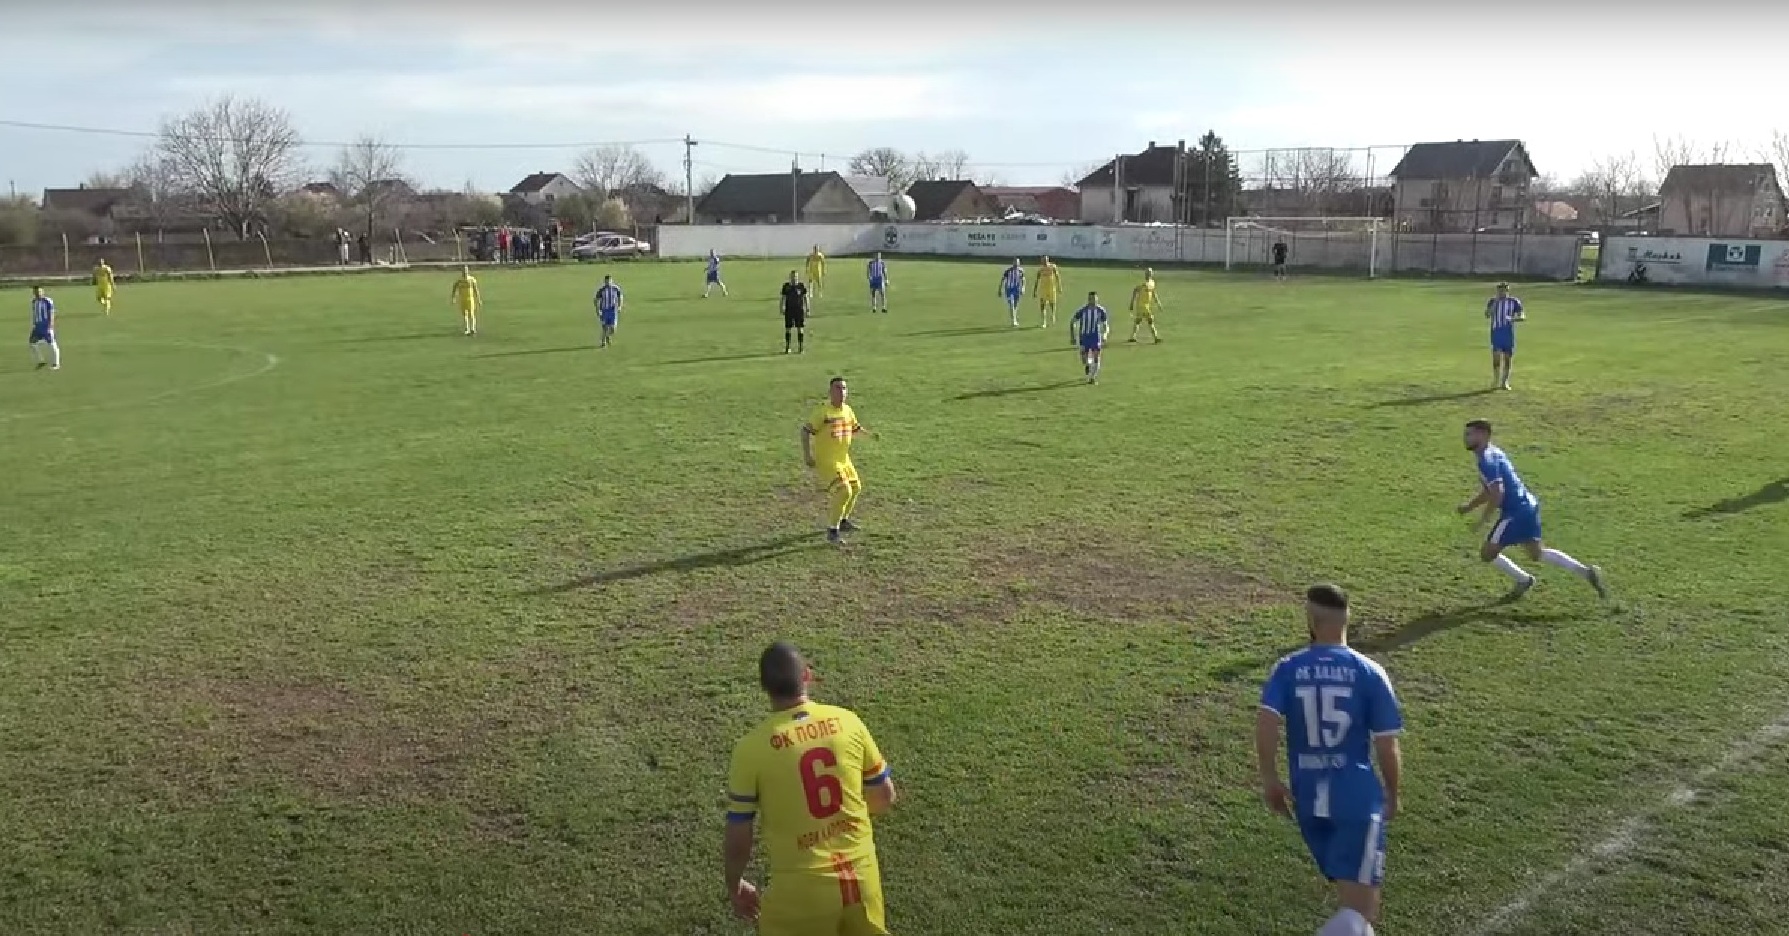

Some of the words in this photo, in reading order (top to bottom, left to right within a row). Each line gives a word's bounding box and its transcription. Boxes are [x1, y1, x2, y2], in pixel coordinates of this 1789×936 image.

[770, 732, 794, 750] ФК
[1295, 686, 1352, 747] 15
[800, 746, 843, 819] 6
